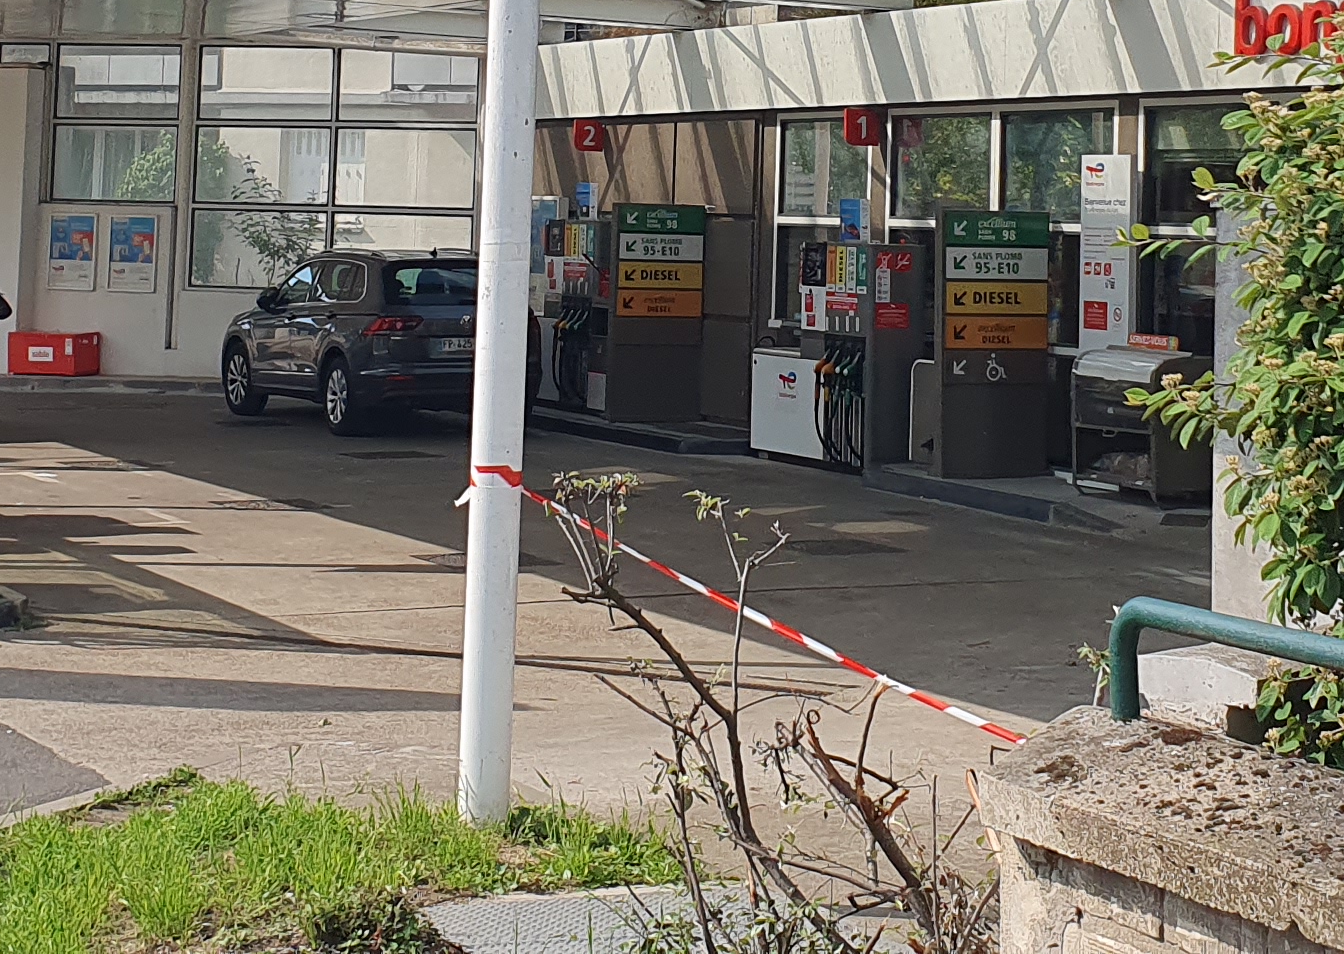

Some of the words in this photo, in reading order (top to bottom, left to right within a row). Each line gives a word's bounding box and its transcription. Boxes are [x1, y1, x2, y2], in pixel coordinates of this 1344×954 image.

[857, 116, 867, 140] 1
[583, 126, 596, 146] 2
[666, 220, 678, 229] 98
[1002, 230, 1016, 241] 98
[643, 246, 680, 257] 95-E10
[975, 262, 1020, 275] 95-E10
[640, 269, 681, 281] DIESEL
[972, 291, 1021, 305] DIESEL
